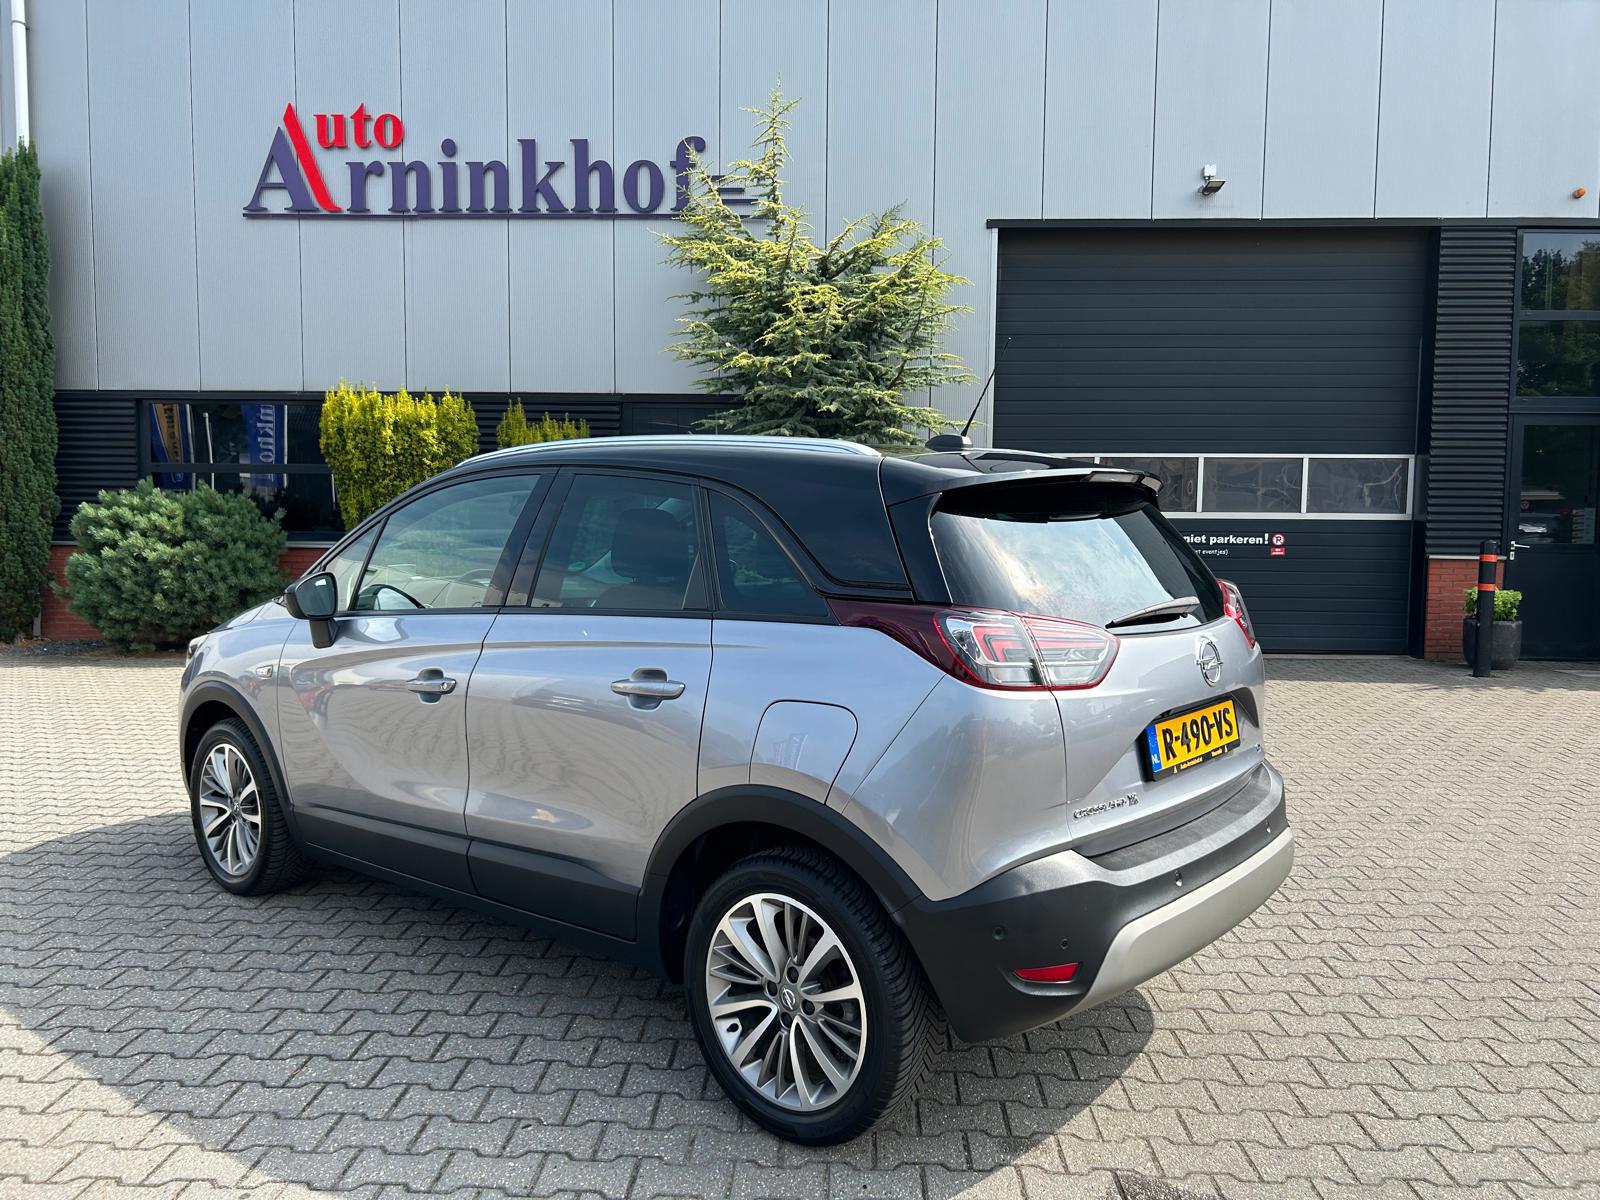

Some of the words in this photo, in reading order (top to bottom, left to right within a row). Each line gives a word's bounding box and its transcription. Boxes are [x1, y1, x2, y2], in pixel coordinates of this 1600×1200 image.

[243, 102, 706, 213] Arninkhof
[1183, 533, 1206, 544] niet
[1209, 533, 1269, 545] parkeren!
[1162, 708, 1233, 762] R-490-VS
[1152, 754, 1160, 764] NL
